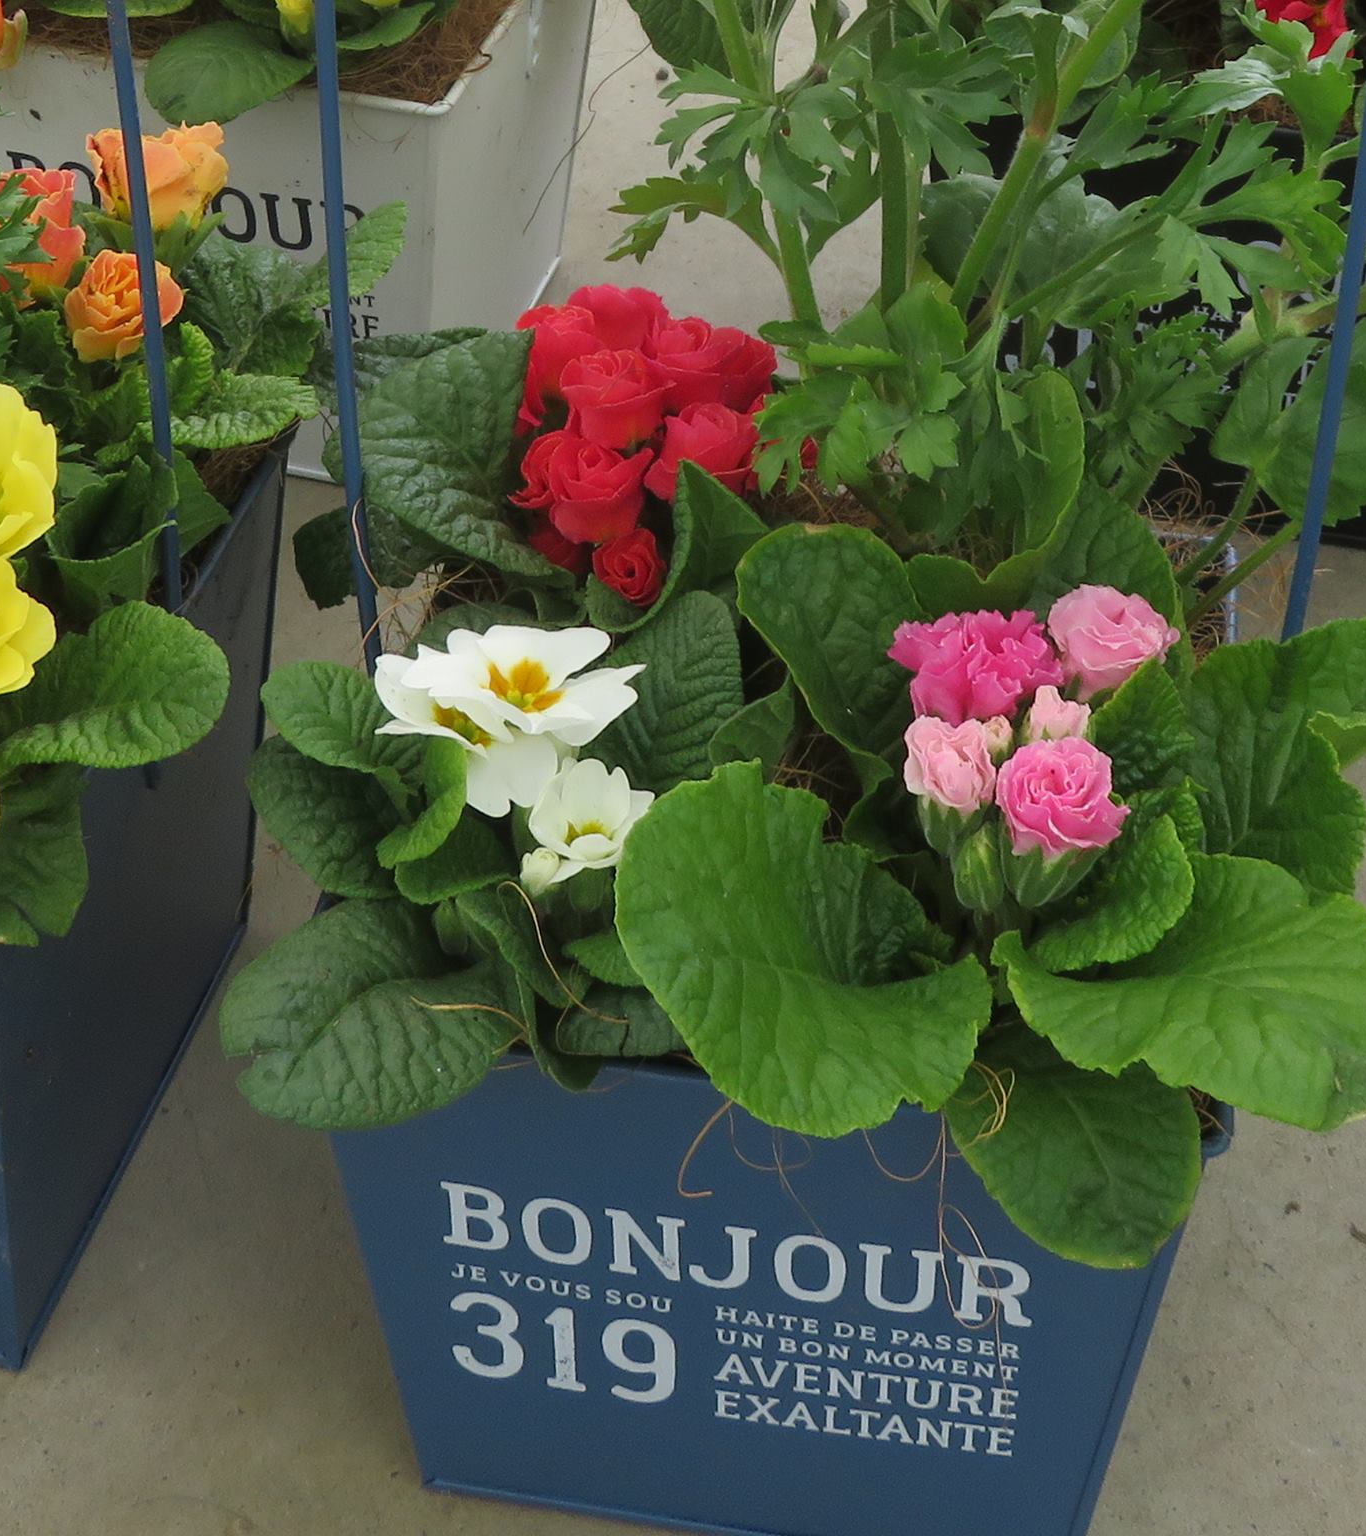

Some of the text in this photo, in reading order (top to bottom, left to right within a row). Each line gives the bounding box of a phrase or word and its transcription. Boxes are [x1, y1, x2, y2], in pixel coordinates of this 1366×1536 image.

[439, 1180, 1032, 1328] BONJOUR
[451, 1263, 673, 1314] JE VOUS SOU
[448, 1291, 677, 1404] 319
[715, 1305, 1020, 1360] HAITE DE PASSER
[715, 1328, 1018, 1381] UN BON MOMENT
[714, 1353, 1018, 1420] AVENTURE
[714, 1389, 1015, 1458] EXALTANTE
